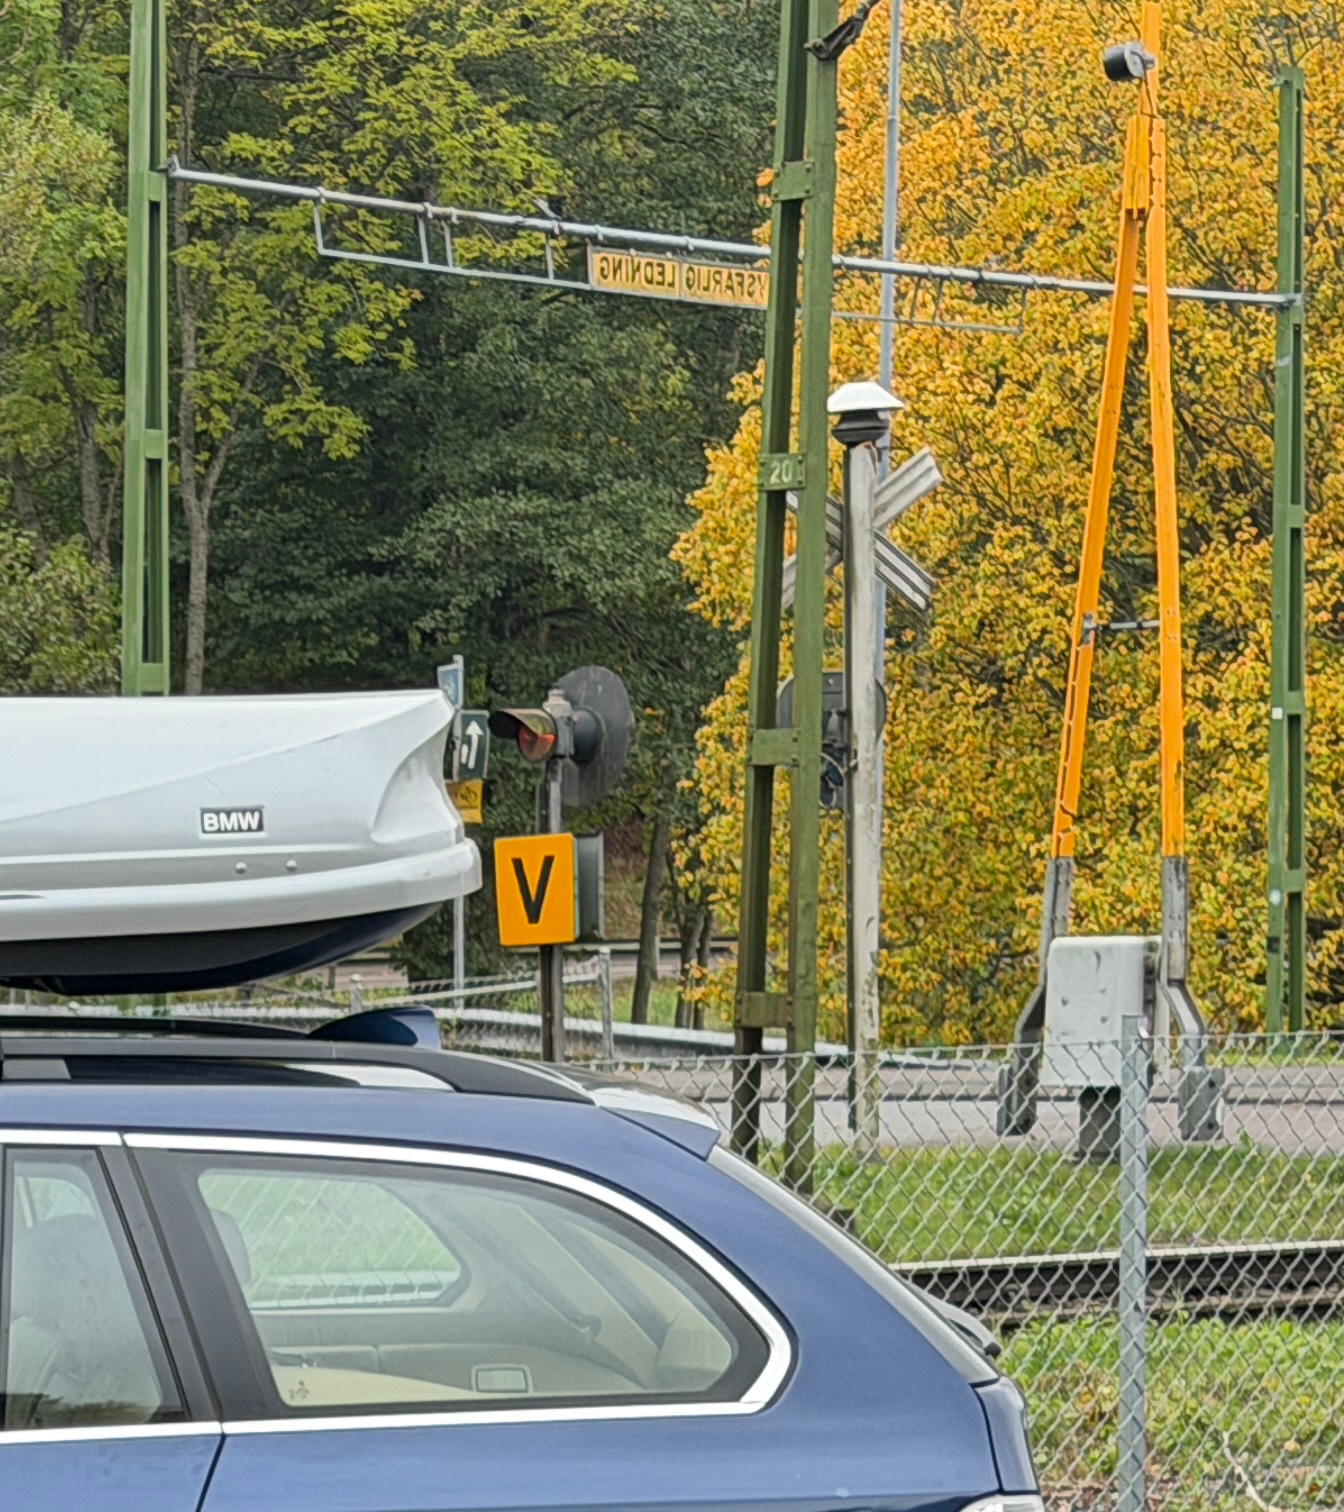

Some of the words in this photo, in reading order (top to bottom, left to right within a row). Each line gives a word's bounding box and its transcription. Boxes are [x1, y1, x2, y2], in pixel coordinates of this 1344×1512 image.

[770, 458, 793, 484] 20
[203, 810, 260, 832] BMW
[511, 855, 555, 925] V
